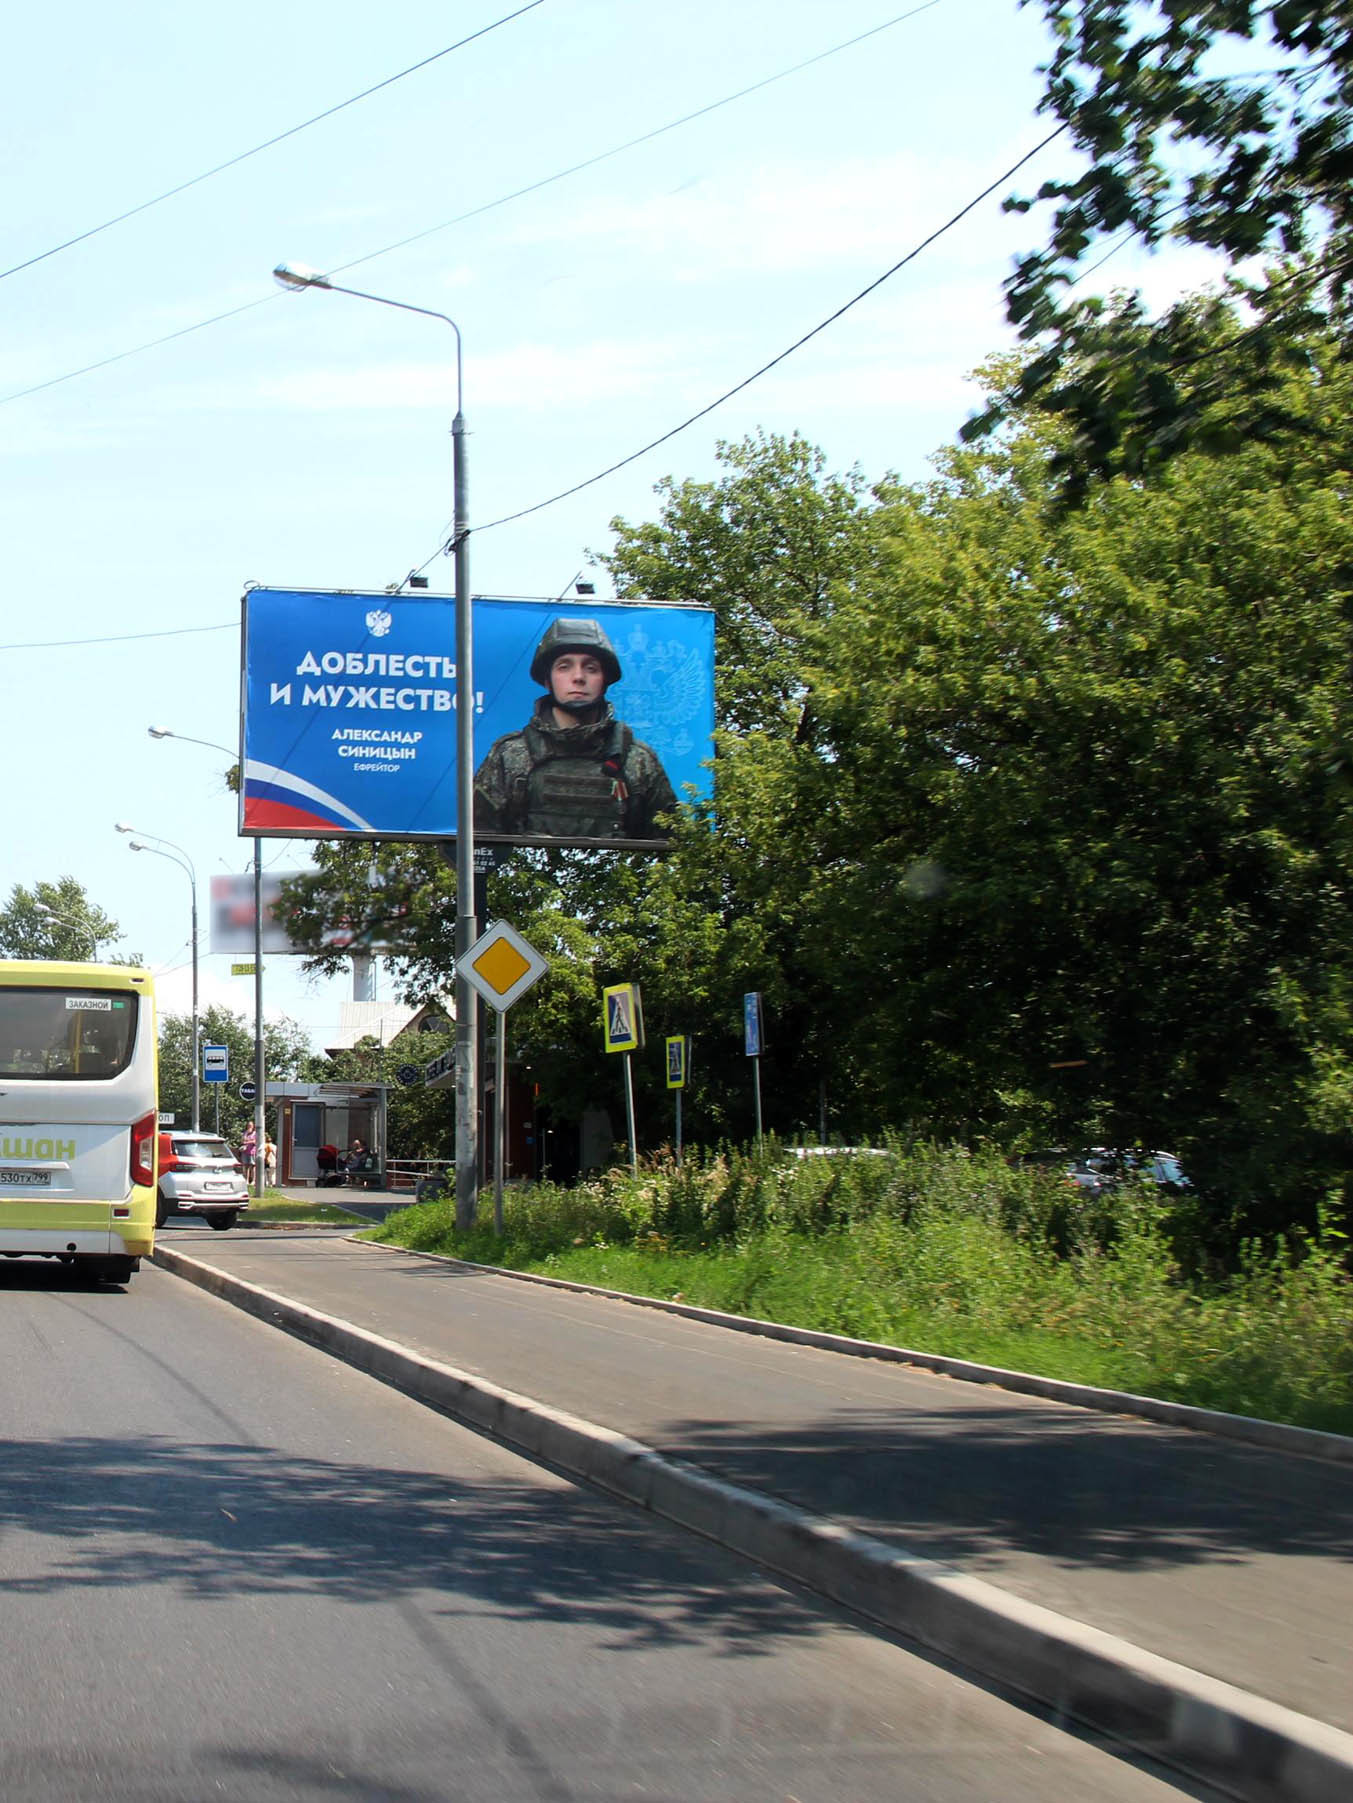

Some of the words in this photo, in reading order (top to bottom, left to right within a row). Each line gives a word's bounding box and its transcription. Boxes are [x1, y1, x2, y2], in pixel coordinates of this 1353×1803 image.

[296, 650, 457, 679] ДОБЛЕСТЬ
[270, 683, 291, 705] И
[331, 728, 423, 744] АЛЕКСАНДР
[338, 745, 416, 760] СИНИЦЫН
[353, 762, 400, 772] ЕФРЕЙТОР
[68, 1000, 109, 1009] ЗАКАЗНОЙ
